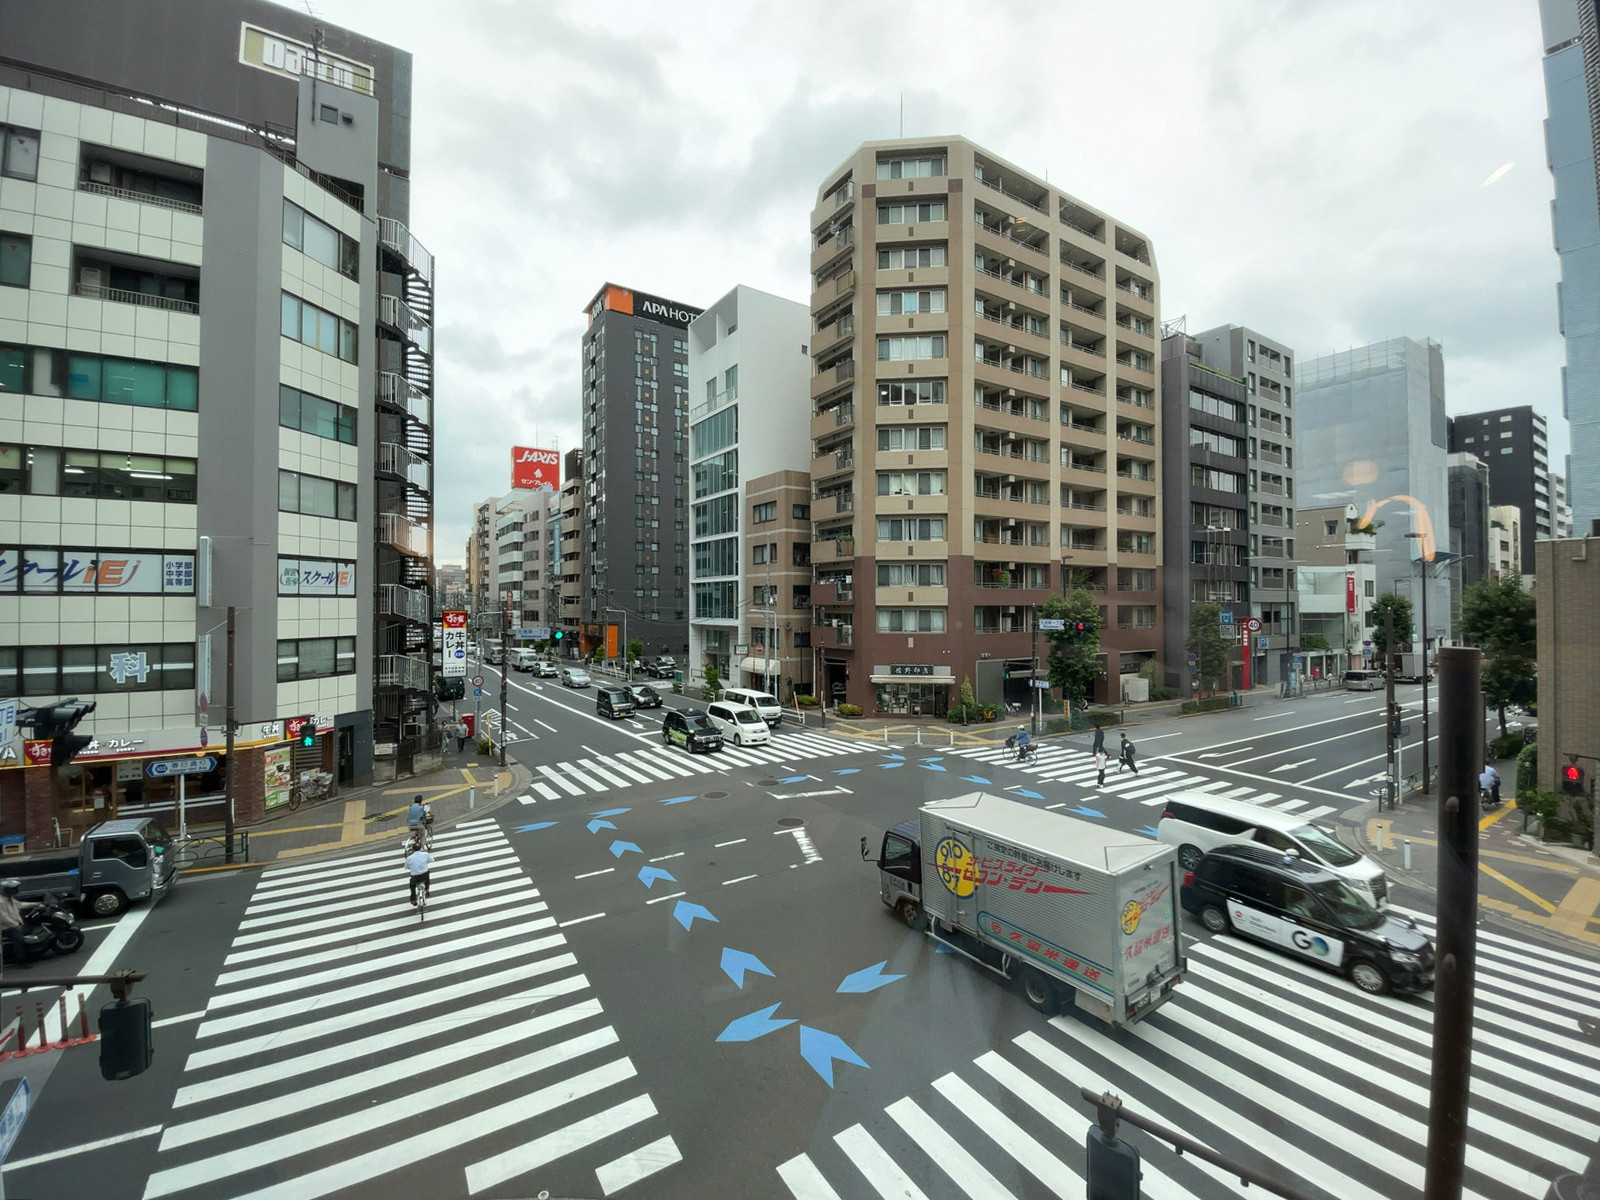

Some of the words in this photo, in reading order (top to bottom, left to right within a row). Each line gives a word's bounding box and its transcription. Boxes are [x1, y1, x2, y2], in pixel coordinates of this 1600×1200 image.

[643, 300, 669, 318] APA
[165, 561, 193, 569] 小学部
[165, 578, 193, 586] 高等部
[301, 571, 336, 585] スクール
[446, 631, 454, 658] カレー
[455, 631, 465, 650] 牛丼
[110, 651, 151, 684] 科
